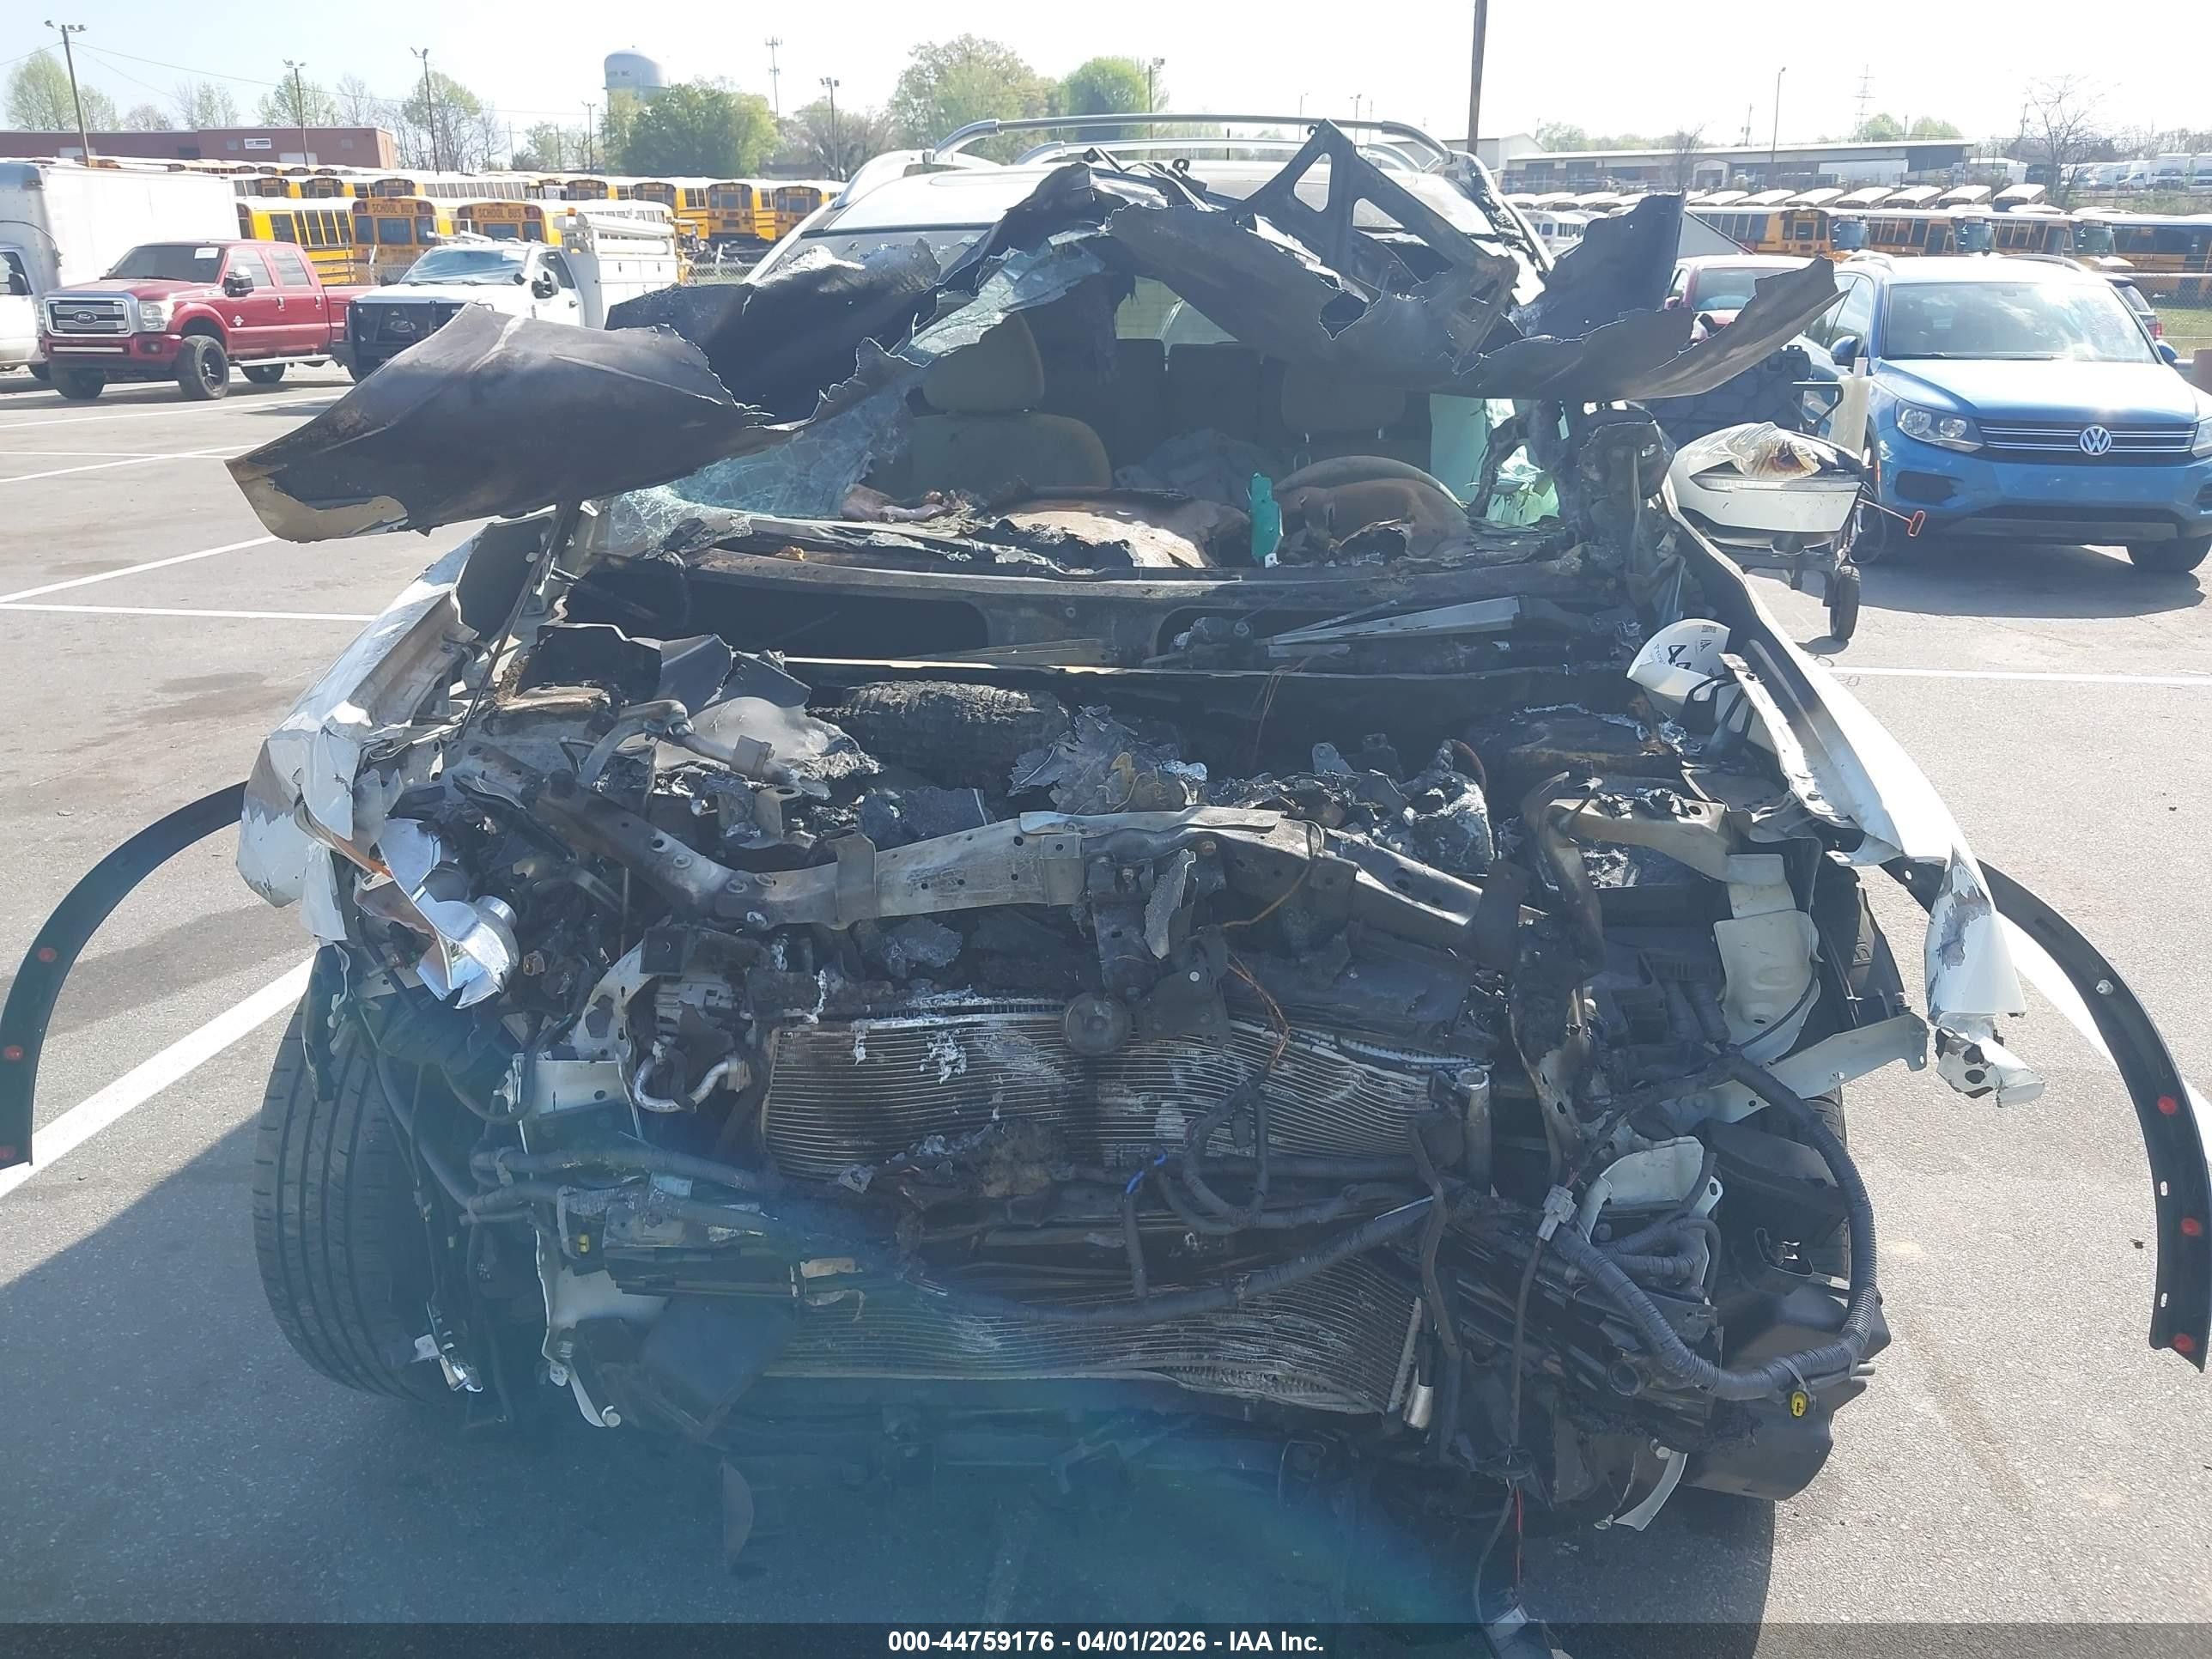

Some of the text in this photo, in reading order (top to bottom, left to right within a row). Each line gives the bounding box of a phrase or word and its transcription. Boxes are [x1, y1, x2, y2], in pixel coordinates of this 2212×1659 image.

[372, 203, 414, 214] SCHOOL BUS
[477, 207, 521, 219] SCHOOL BUS
